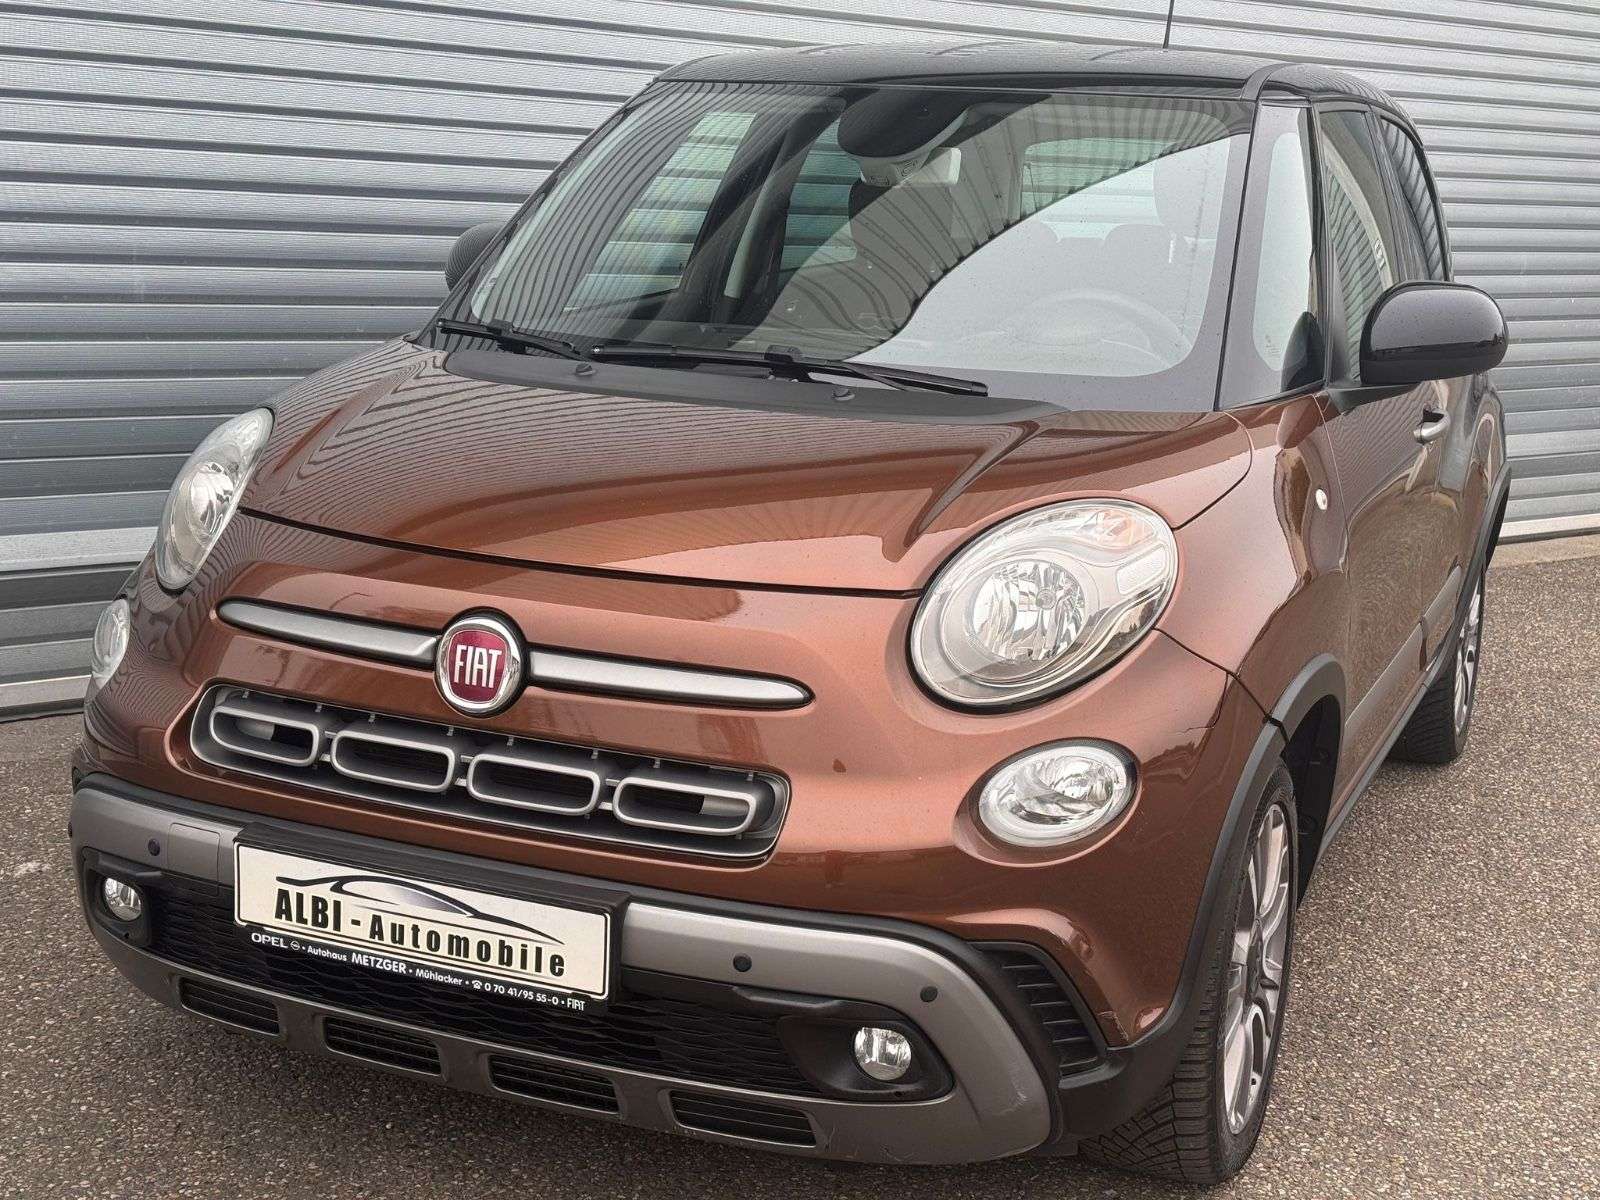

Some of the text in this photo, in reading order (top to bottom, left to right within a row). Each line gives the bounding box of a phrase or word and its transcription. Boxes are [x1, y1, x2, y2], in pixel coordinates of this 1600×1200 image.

[453, 644, 502, 689] FIAT
[251, 932, 289, 949] OPEL
[307, 945, 348, 962] Autohaus
[351, 952, 407, 975] METZGER
[415, 968, 463, 986] Mühlacker
[566, 997, 586, 1012] FIAT
[274, 888, 342, 932] ALBI
[369, 914, 565, 977] Automobile
